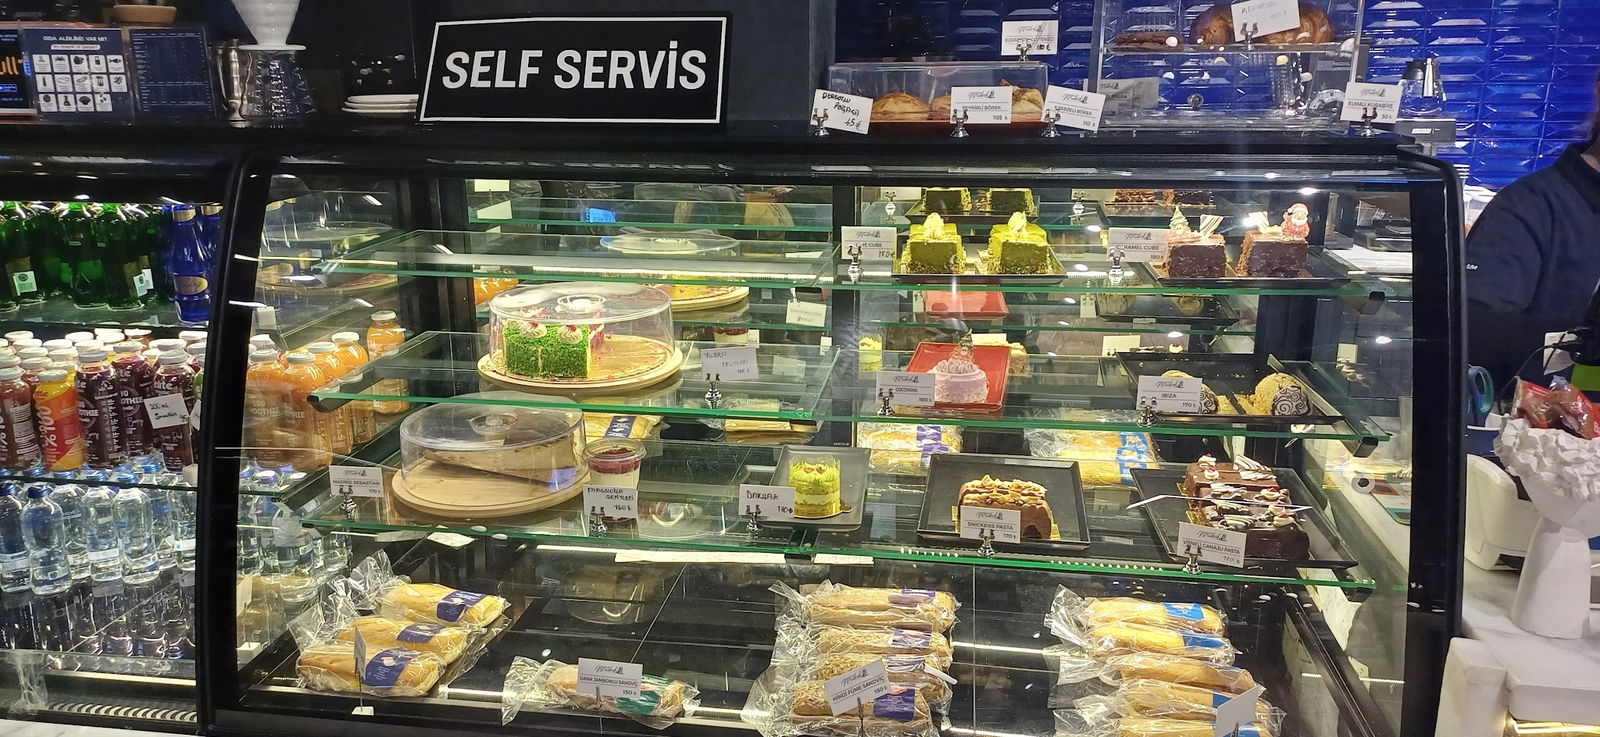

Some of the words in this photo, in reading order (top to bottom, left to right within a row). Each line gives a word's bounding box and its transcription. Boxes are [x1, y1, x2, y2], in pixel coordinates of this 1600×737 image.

[442, 50, 543, 89] SELF
[554, 40, 706, 90] SERVİS
[967, 521, 995, 529] SNICKERS
[1224, 546, 1240, 555] PASTA
